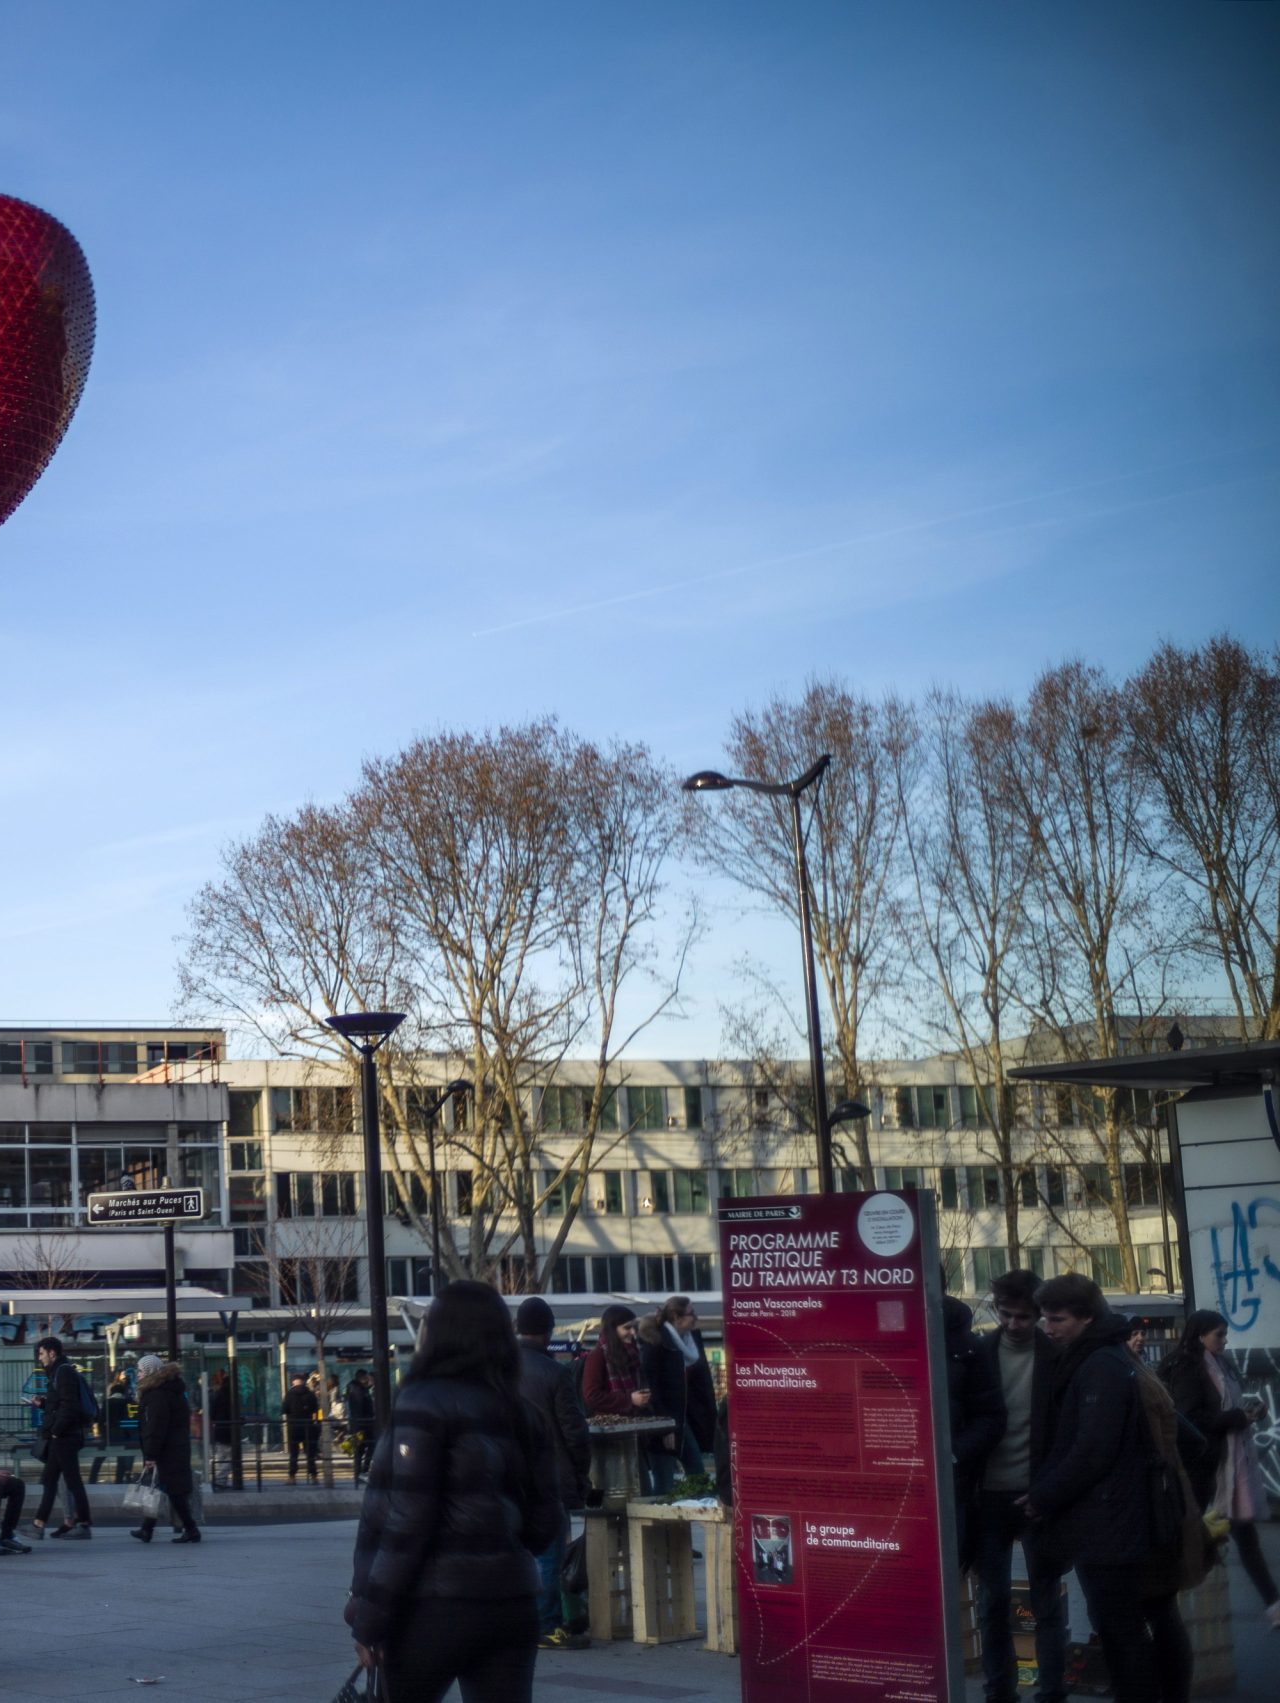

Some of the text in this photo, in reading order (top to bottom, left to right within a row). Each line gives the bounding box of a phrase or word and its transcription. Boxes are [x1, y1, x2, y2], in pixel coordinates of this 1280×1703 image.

[108, 1198, 140, 1208] Marchés
[160, 1197, 182, 1205] Puces
[108, 1209, 127, 1217] (Paris
[137, 1208, 176, 1216] Saint-Ouen)
[728, 1209, 786, 1219] MAIRIE DE PARIS
[730, 1232, 839, 1250] PROGRAMME
[730, 1251, 823, 1269] ARTISTIQUE
[732, 1268, 914, 1287] DU TRAMWAY T3 NORD
[732, 1296, 823, 1309] Joana Vasconcelos
[735, 1363, 808, 1376] Les Nouveaux
[736, 1375, 817, 1388] commanditaires
[806, 1521, 855, 1538] Le groupe
[806, 1533, 900, 1551] de commanditaires
